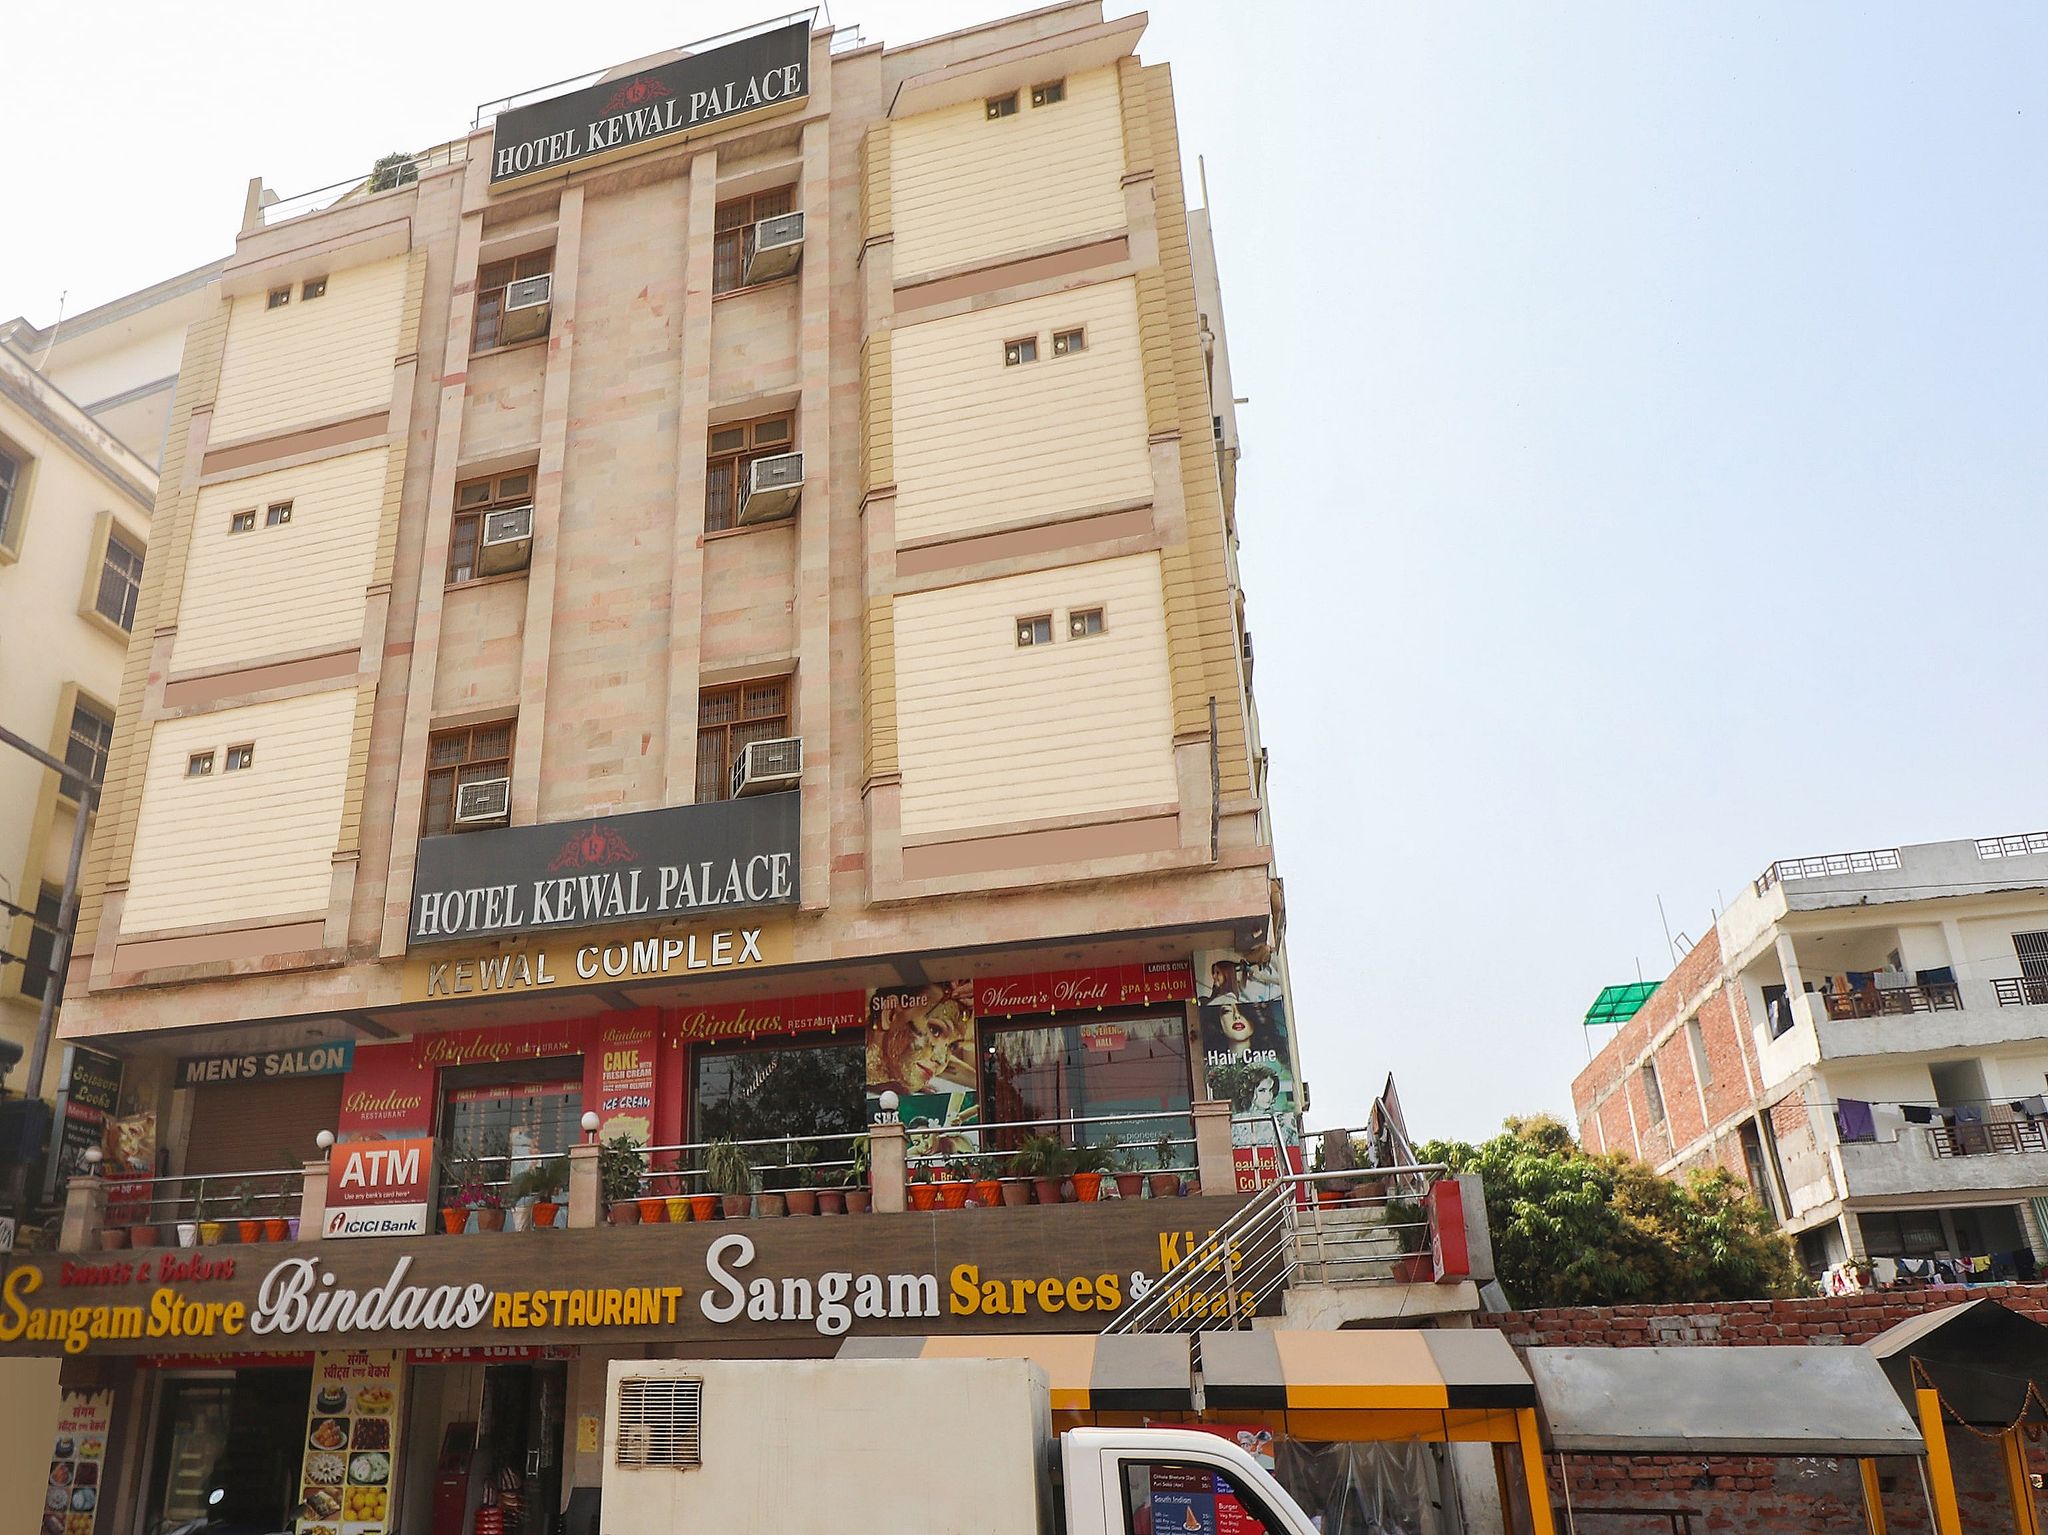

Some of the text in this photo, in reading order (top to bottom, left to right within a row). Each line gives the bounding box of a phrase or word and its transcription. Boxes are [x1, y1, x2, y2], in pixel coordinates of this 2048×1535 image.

[495, 63, 801, 177] HOTEL KEWAL PALACE
[416, 852, 792, 936] HOTEL KEWAL PALACE
[427, 927, 764, 996] KEWAL COMPLEX
[1148, 962, 1189, 973] LADIES ONLY
[982, 977, 1108, 1008] Women's World
[1121, 984, 1140, 995] SPA
[1154, 980, 1187, 991] SALON
[872, 994, 928, 1011] Skin Care
[603, 1026, 652, 1042] Bindaas
[681, 1008, 854, 1039] Bindaas RESTAURANT
[424, 1034, 512, 1062] Bindaas
[603, 1050, 639, 1072] CAKE
[1207, 1048, 1277, 1066] Hair Care
[186, 1048, 345, 1082] MEN'S SALON
[603, 1068, 652, 1080] FRESH CREAM
[345, 1089, 422, 1113] Bindaas
[603, 1096, 650, 1111] ICE CREAM
[360, 1110, 407, 1120] RESTAURANT
[340, 1149, 420, 1188] ATM
[345, 1219, 417, 1233] ICICI Bank
[159, 1251, 235, 1284] Bakers
[250, 1256, 682, 1336] Bindaas RESTAURANT
[699, 1233, 1154, 1337] Sangam Sarees &
[0, 1264, 245, 1354] Sangam Store
[1164, 1284, 1257, 1319] Weas
[1154, 1494, 1192, 1504] South Indian
[1218, 1502, 1238, 1511] Burger
